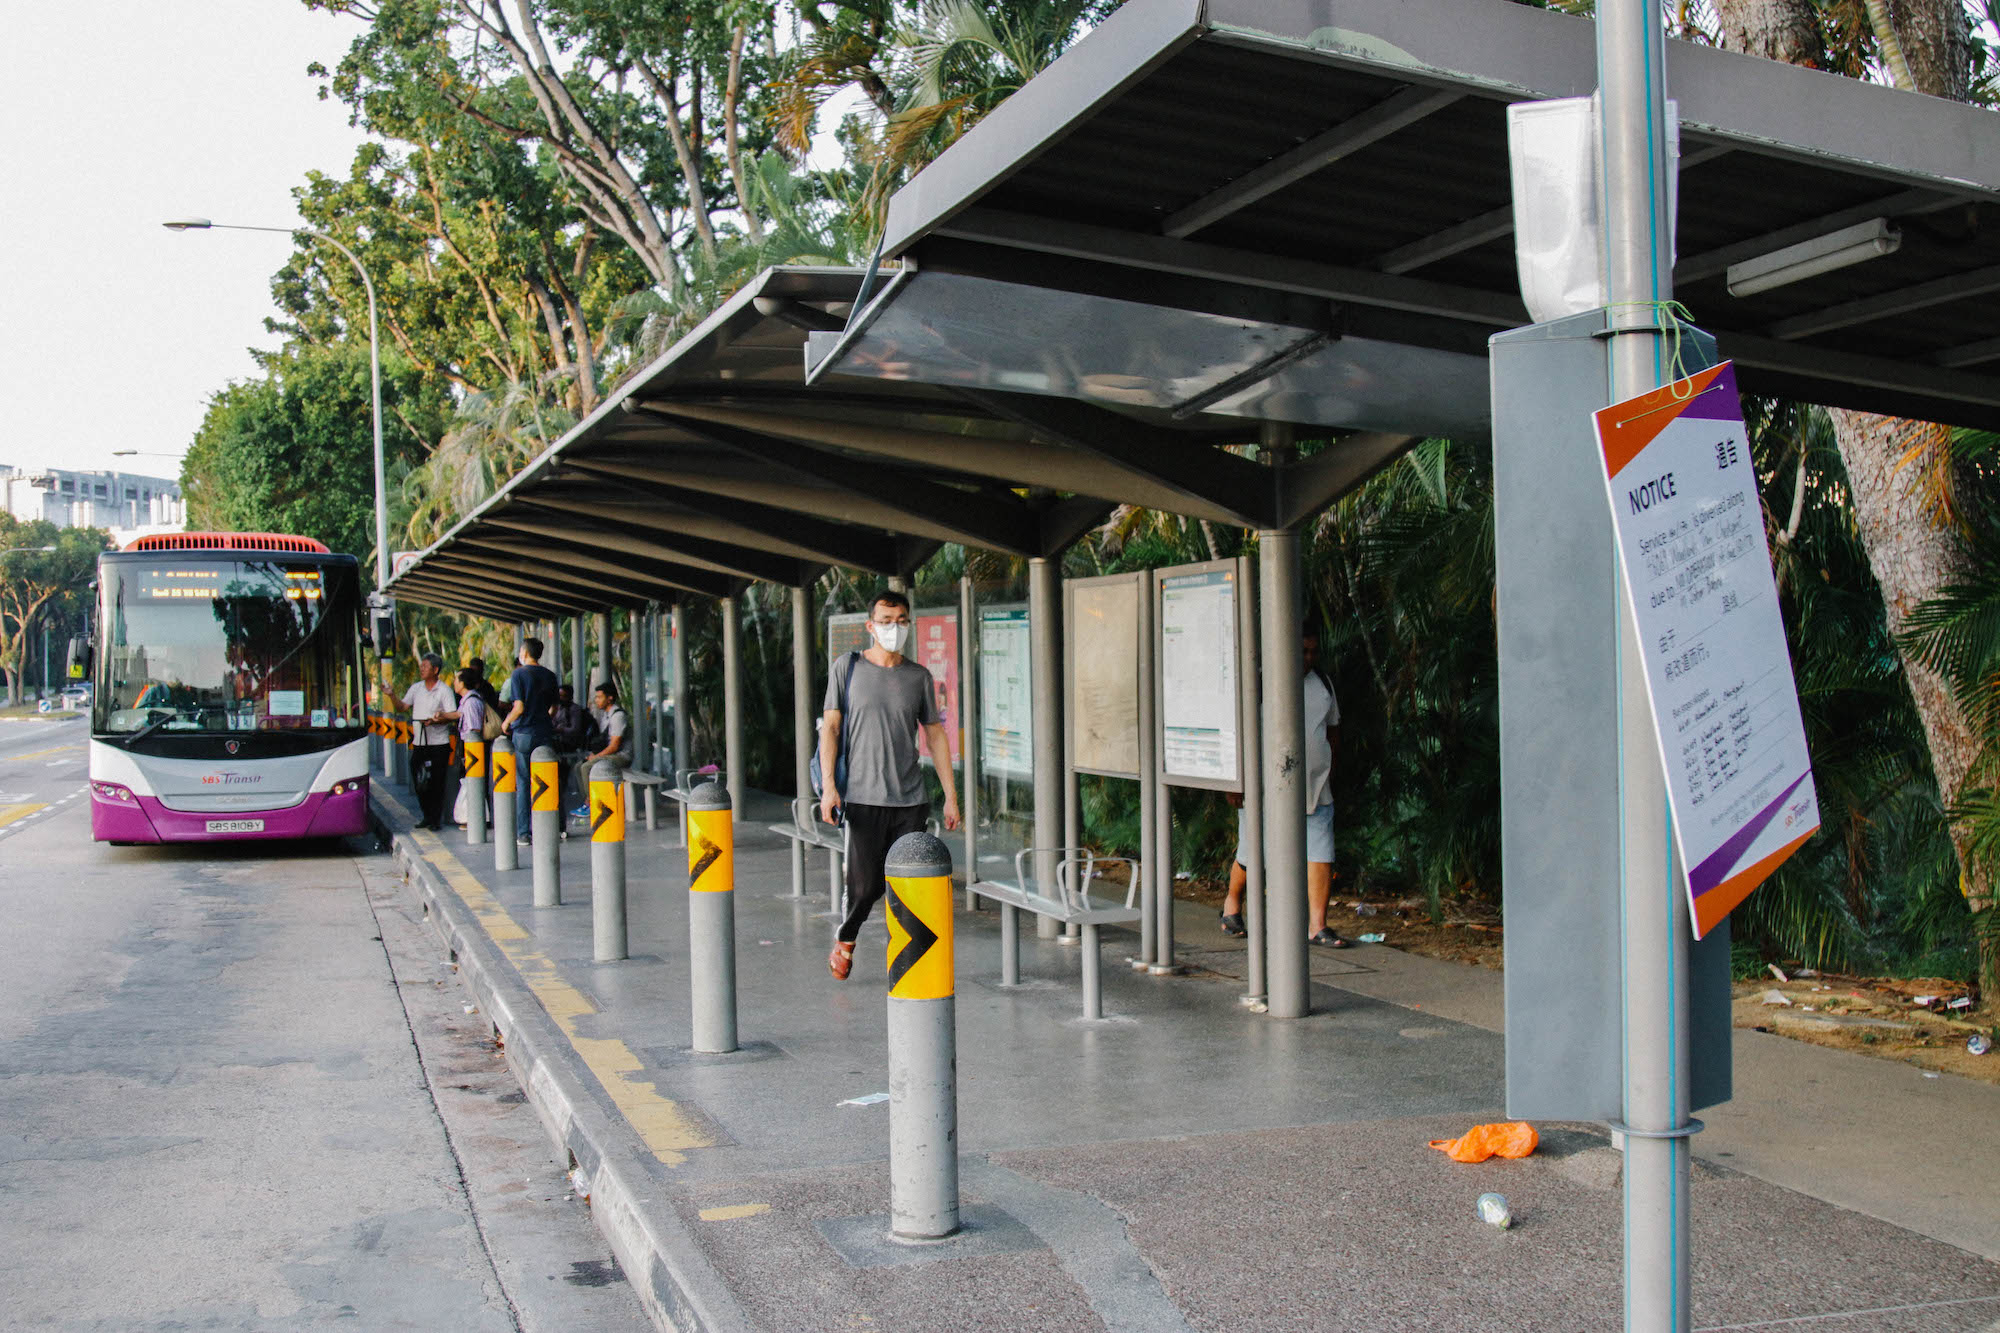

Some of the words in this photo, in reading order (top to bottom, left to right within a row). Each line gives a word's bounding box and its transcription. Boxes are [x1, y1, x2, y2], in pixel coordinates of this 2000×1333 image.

[1715, 438, 1738, 469] 通告
[1629, 472, 1677, 515] NOTICE
[1639, 531, 1667, 556] Service
[1651, 591, 1666, 608] due
[1666, 586, 1675, 599] to
[201, 775, 221, 785] SBS
[221, 773, 263, 785] Transit
